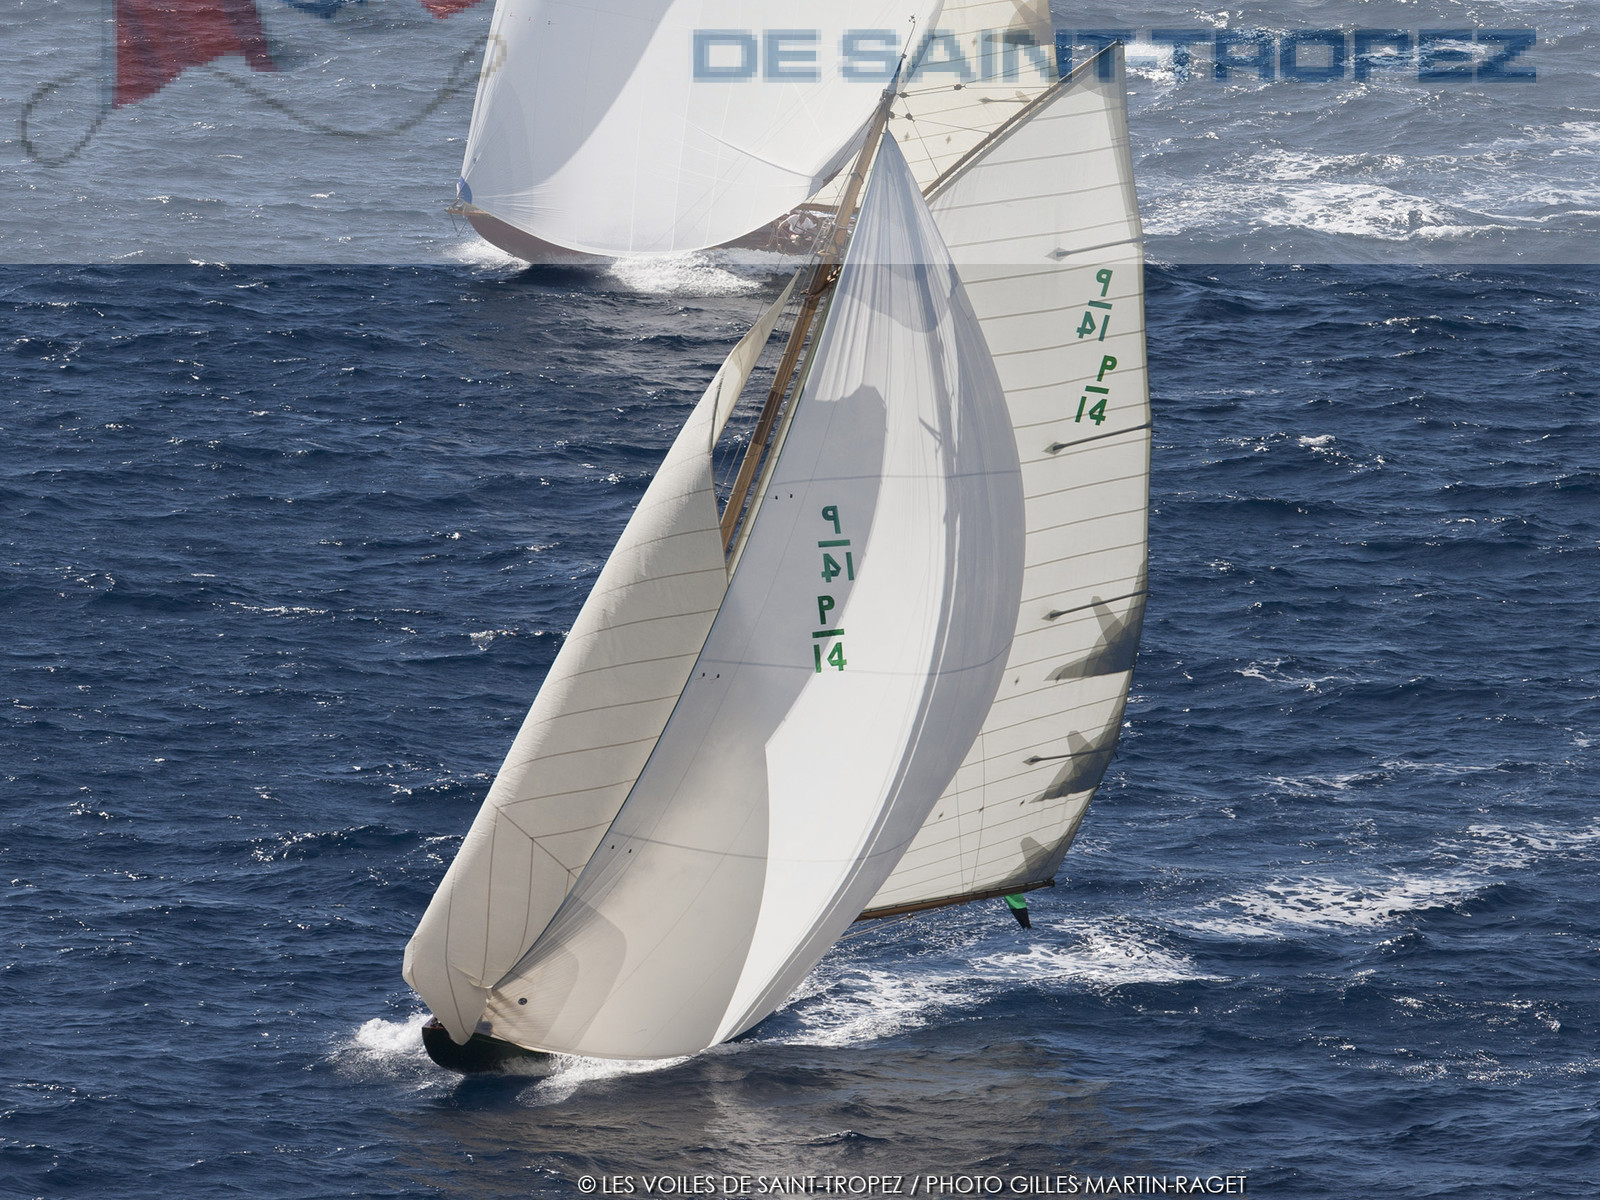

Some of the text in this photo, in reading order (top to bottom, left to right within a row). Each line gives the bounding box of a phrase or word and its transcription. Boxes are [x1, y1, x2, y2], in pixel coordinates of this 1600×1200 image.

[1096, 355, 1117, 382] P
[1075, 396, 1107, 426] 14
[817, 595, 835, 625] P
[813, 642, 847, 673] 14
